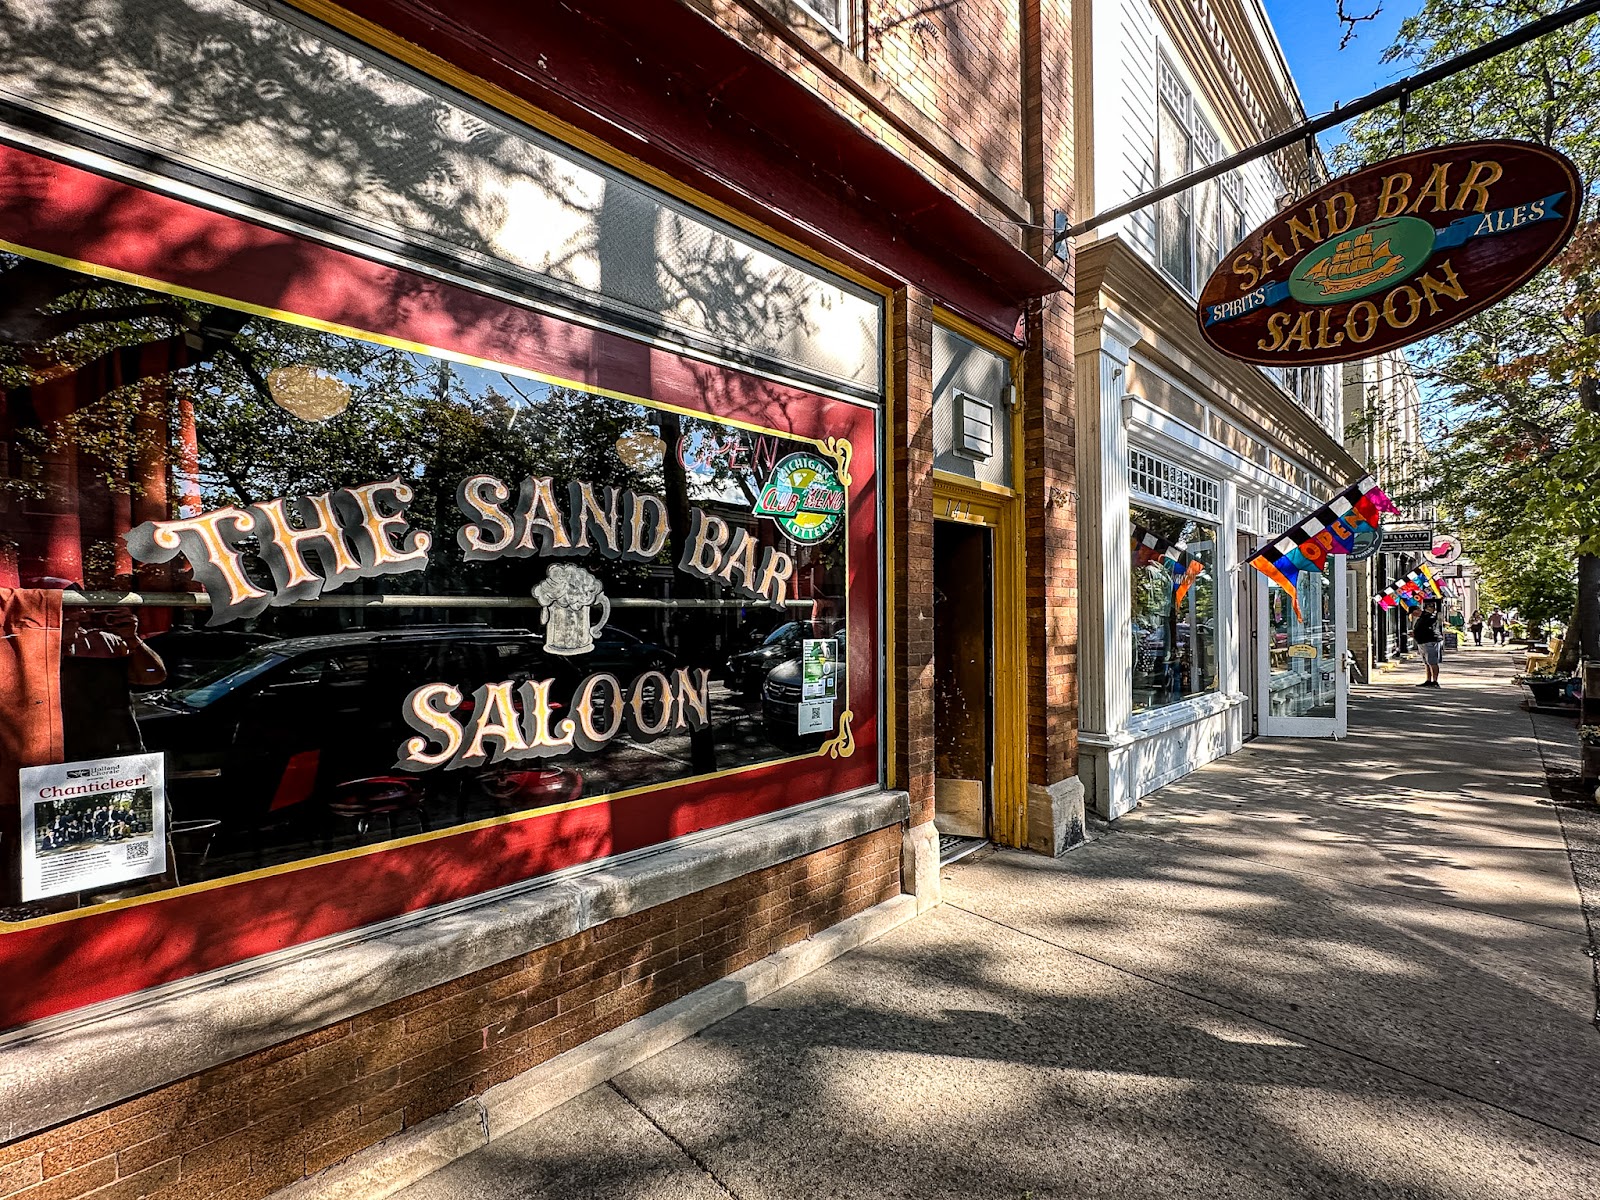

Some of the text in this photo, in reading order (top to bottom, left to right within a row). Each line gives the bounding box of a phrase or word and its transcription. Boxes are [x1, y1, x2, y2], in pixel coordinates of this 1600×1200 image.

[1231, 160, 1504, 291] SAND BAR
[1474, 200, 1546, 236] ALES
[1212, 288, 1266, 321] SPIRITS
[1257, 258, 1470, 353] SALOON
[762, 487, 846, 513] CLUB KENO
[785, 515, 834, 540] LOTTERY
[1298, 507, 1366, 561] OPEN
[138, 474, 793, 617] THE SAND BAR
[1355, 546, 1375, 559] rentals
[395, 666, 711, 771] SALOON
[91, 764, 121, 774] Holland
[39, 774, 147, 799] Chanticleer!
